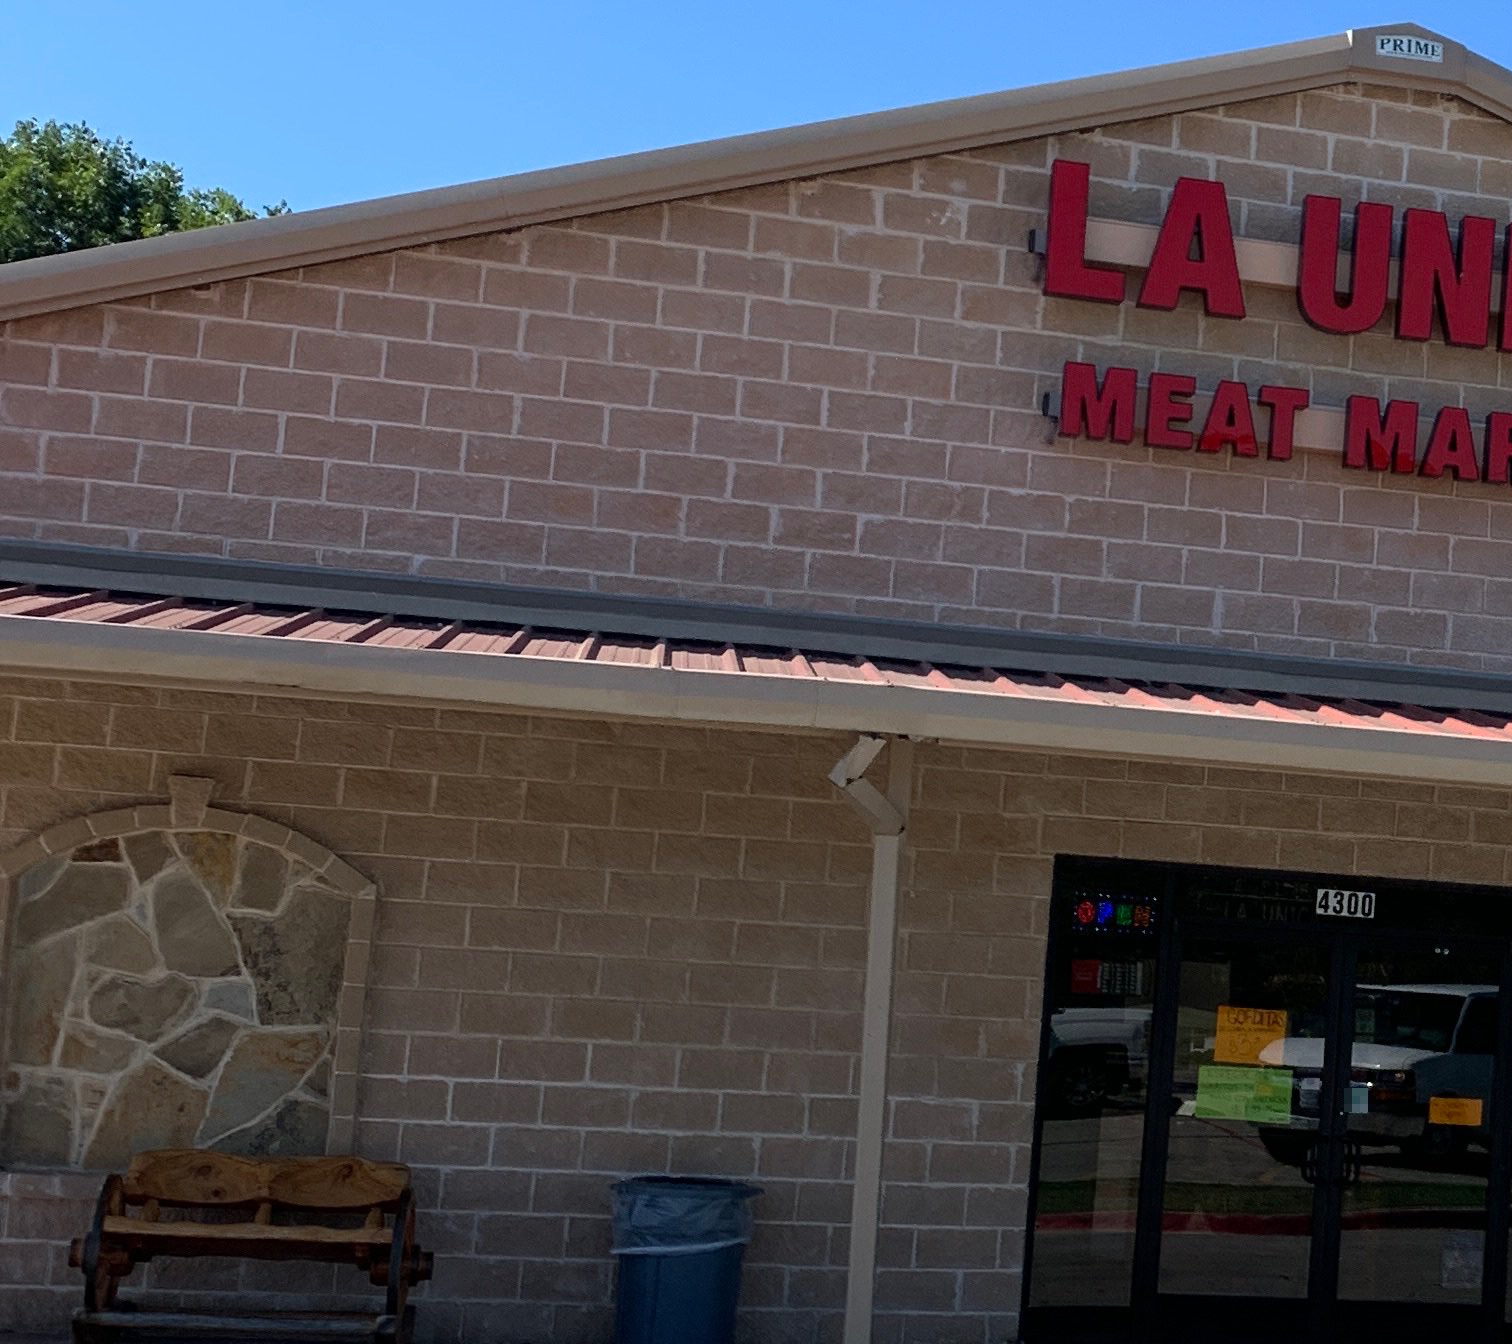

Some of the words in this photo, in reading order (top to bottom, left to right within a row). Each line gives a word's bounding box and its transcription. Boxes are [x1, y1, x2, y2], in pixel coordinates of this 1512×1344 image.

[1379, 38, 1441, 57] PRIME
[1043, 158, 1246, 319] LA
[1059, 361, 1310, 460] MEAT
[1318, 890, 1374, 917] 4300
